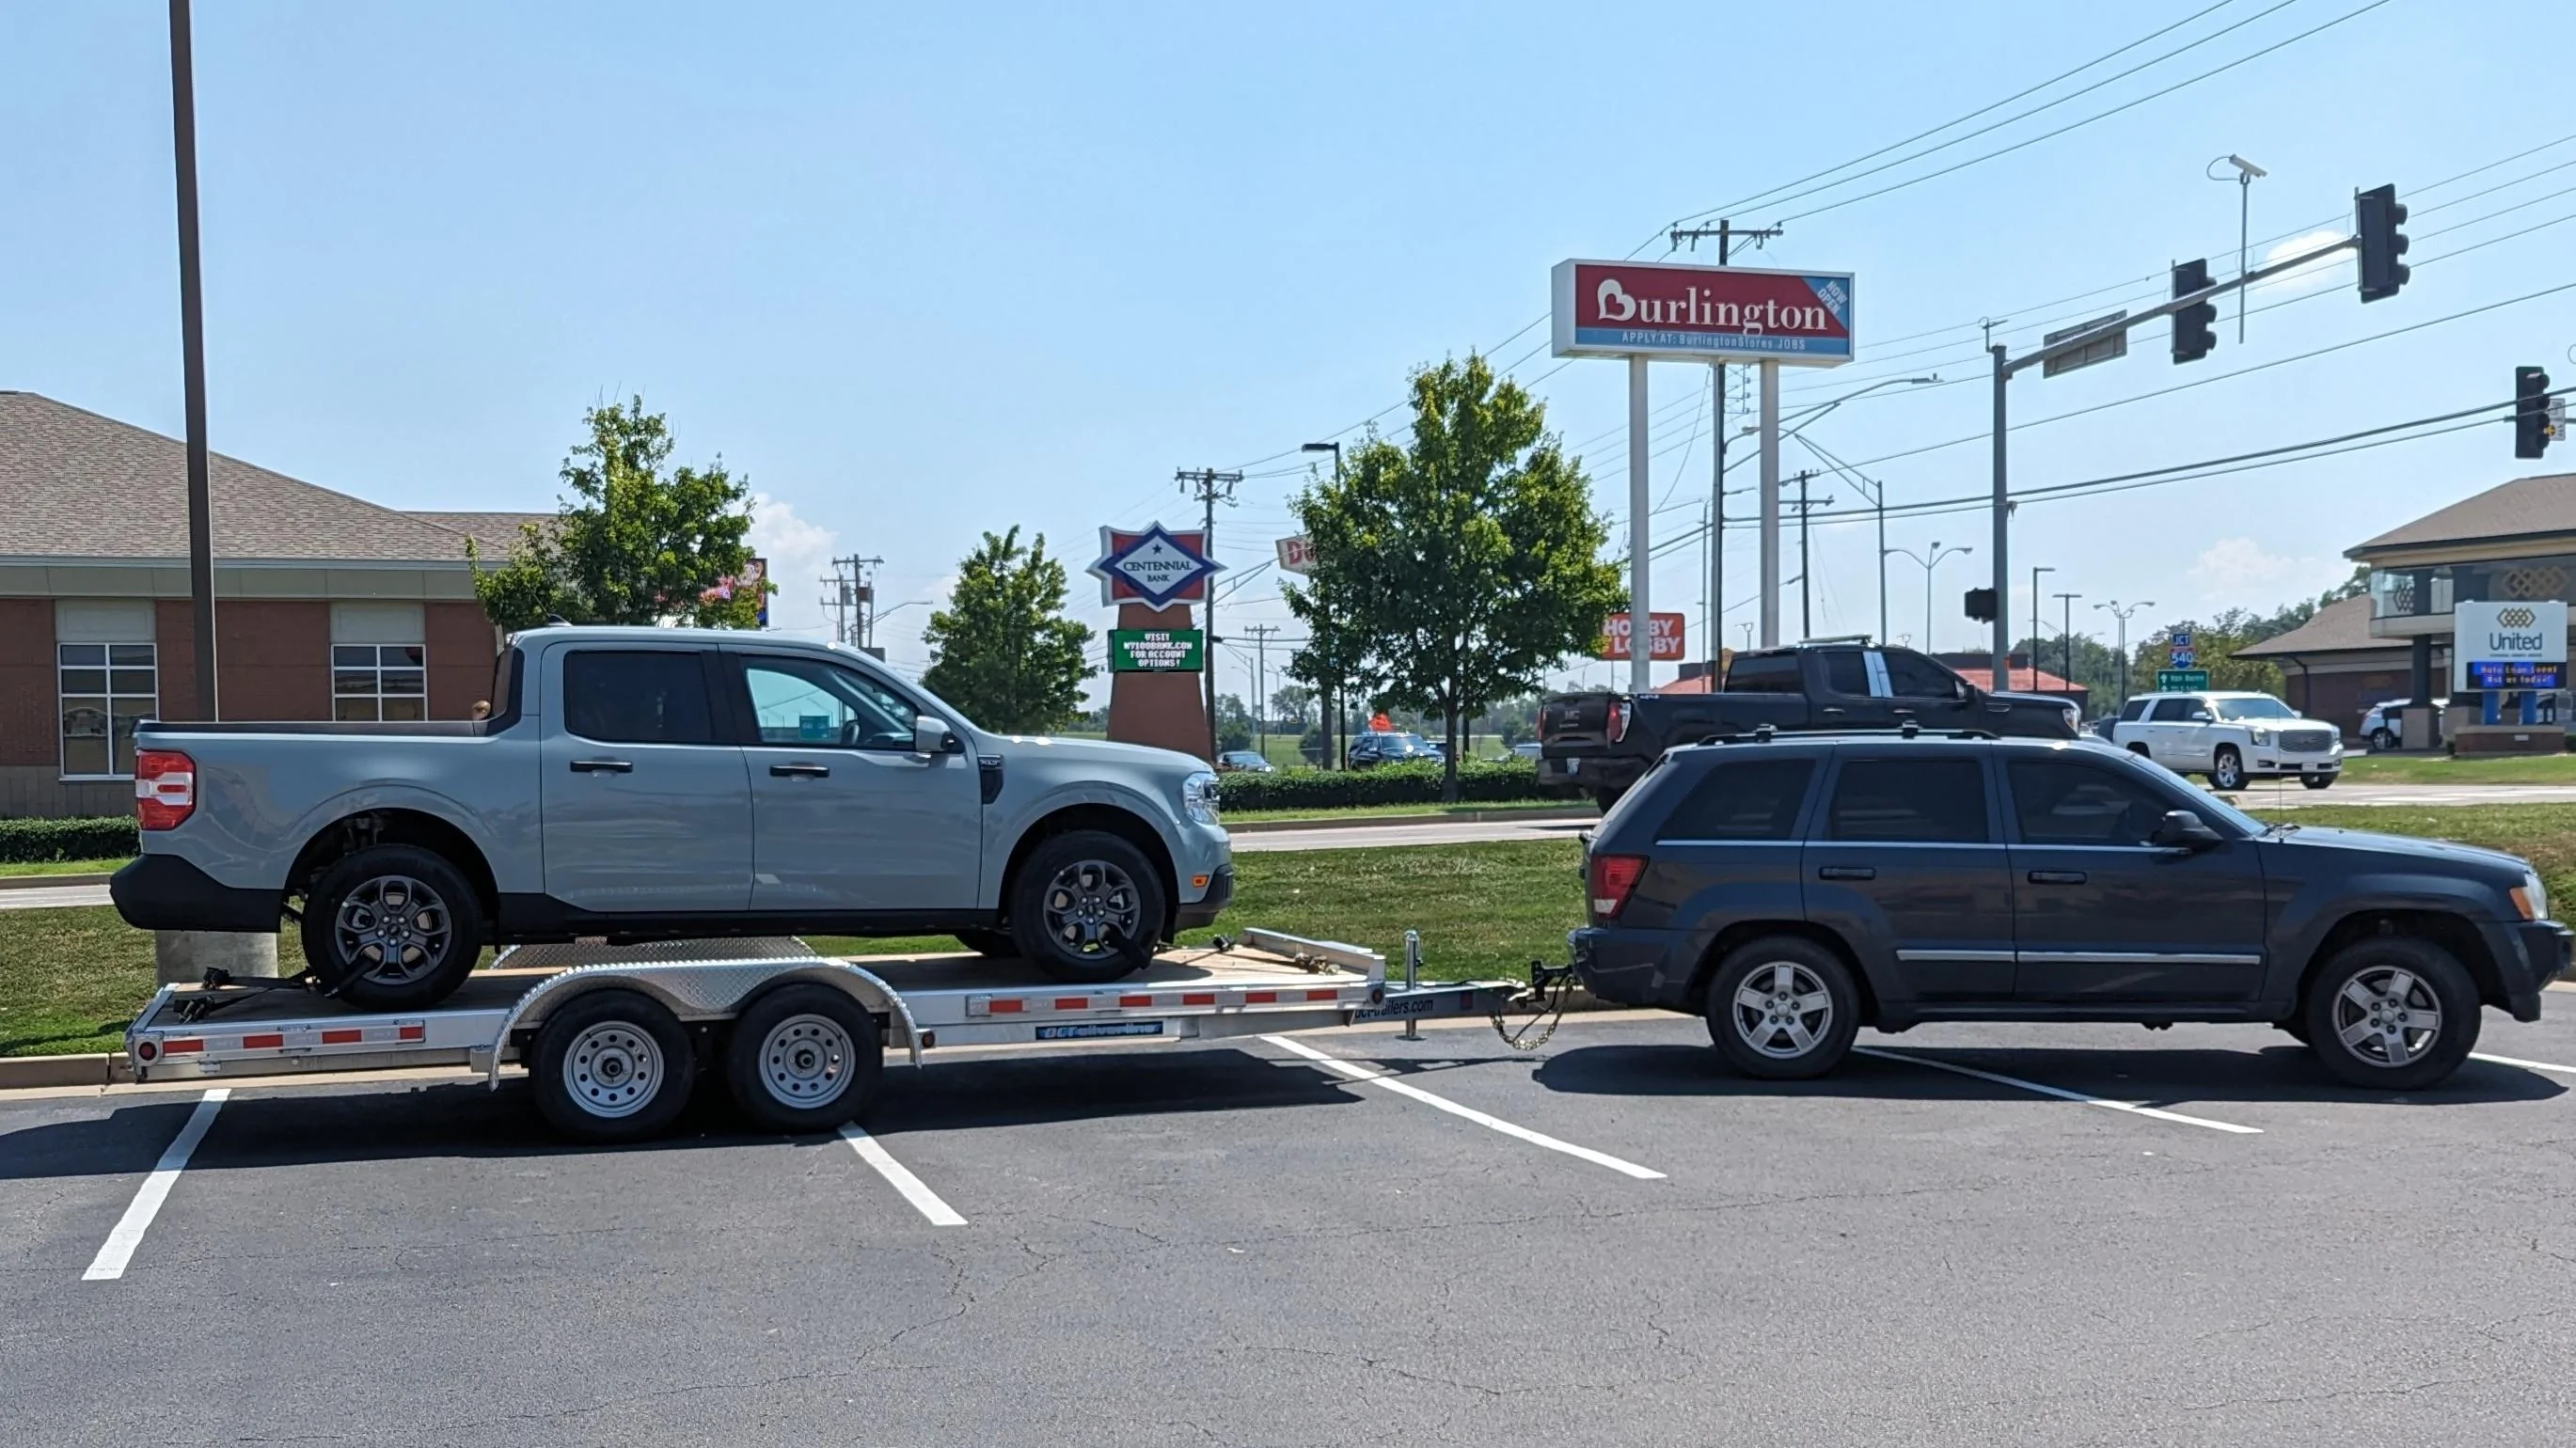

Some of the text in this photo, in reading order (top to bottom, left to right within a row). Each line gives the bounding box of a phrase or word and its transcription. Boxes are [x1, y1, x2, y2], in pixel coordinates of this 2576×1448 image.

[1826, 281, 1848, 305] NOW
[1817, 288, 1841, 314] OPEN
[1597, 278, 1828, 337] Burlington
[1621, 331, 1656, 343] APPLY
[1123, 560, 1193, 572] CENTENNIAL
[1603, 619, 1674, 637] HOBY
[1145, 633, 1170, 641] VISIT
[2175, 636, 2189, 644] JCT
[2489, 632, 2543, 651] United
[1147, 650, 1186, 658] ACCOUNT
[2172, 653, 2193, 663] 540
